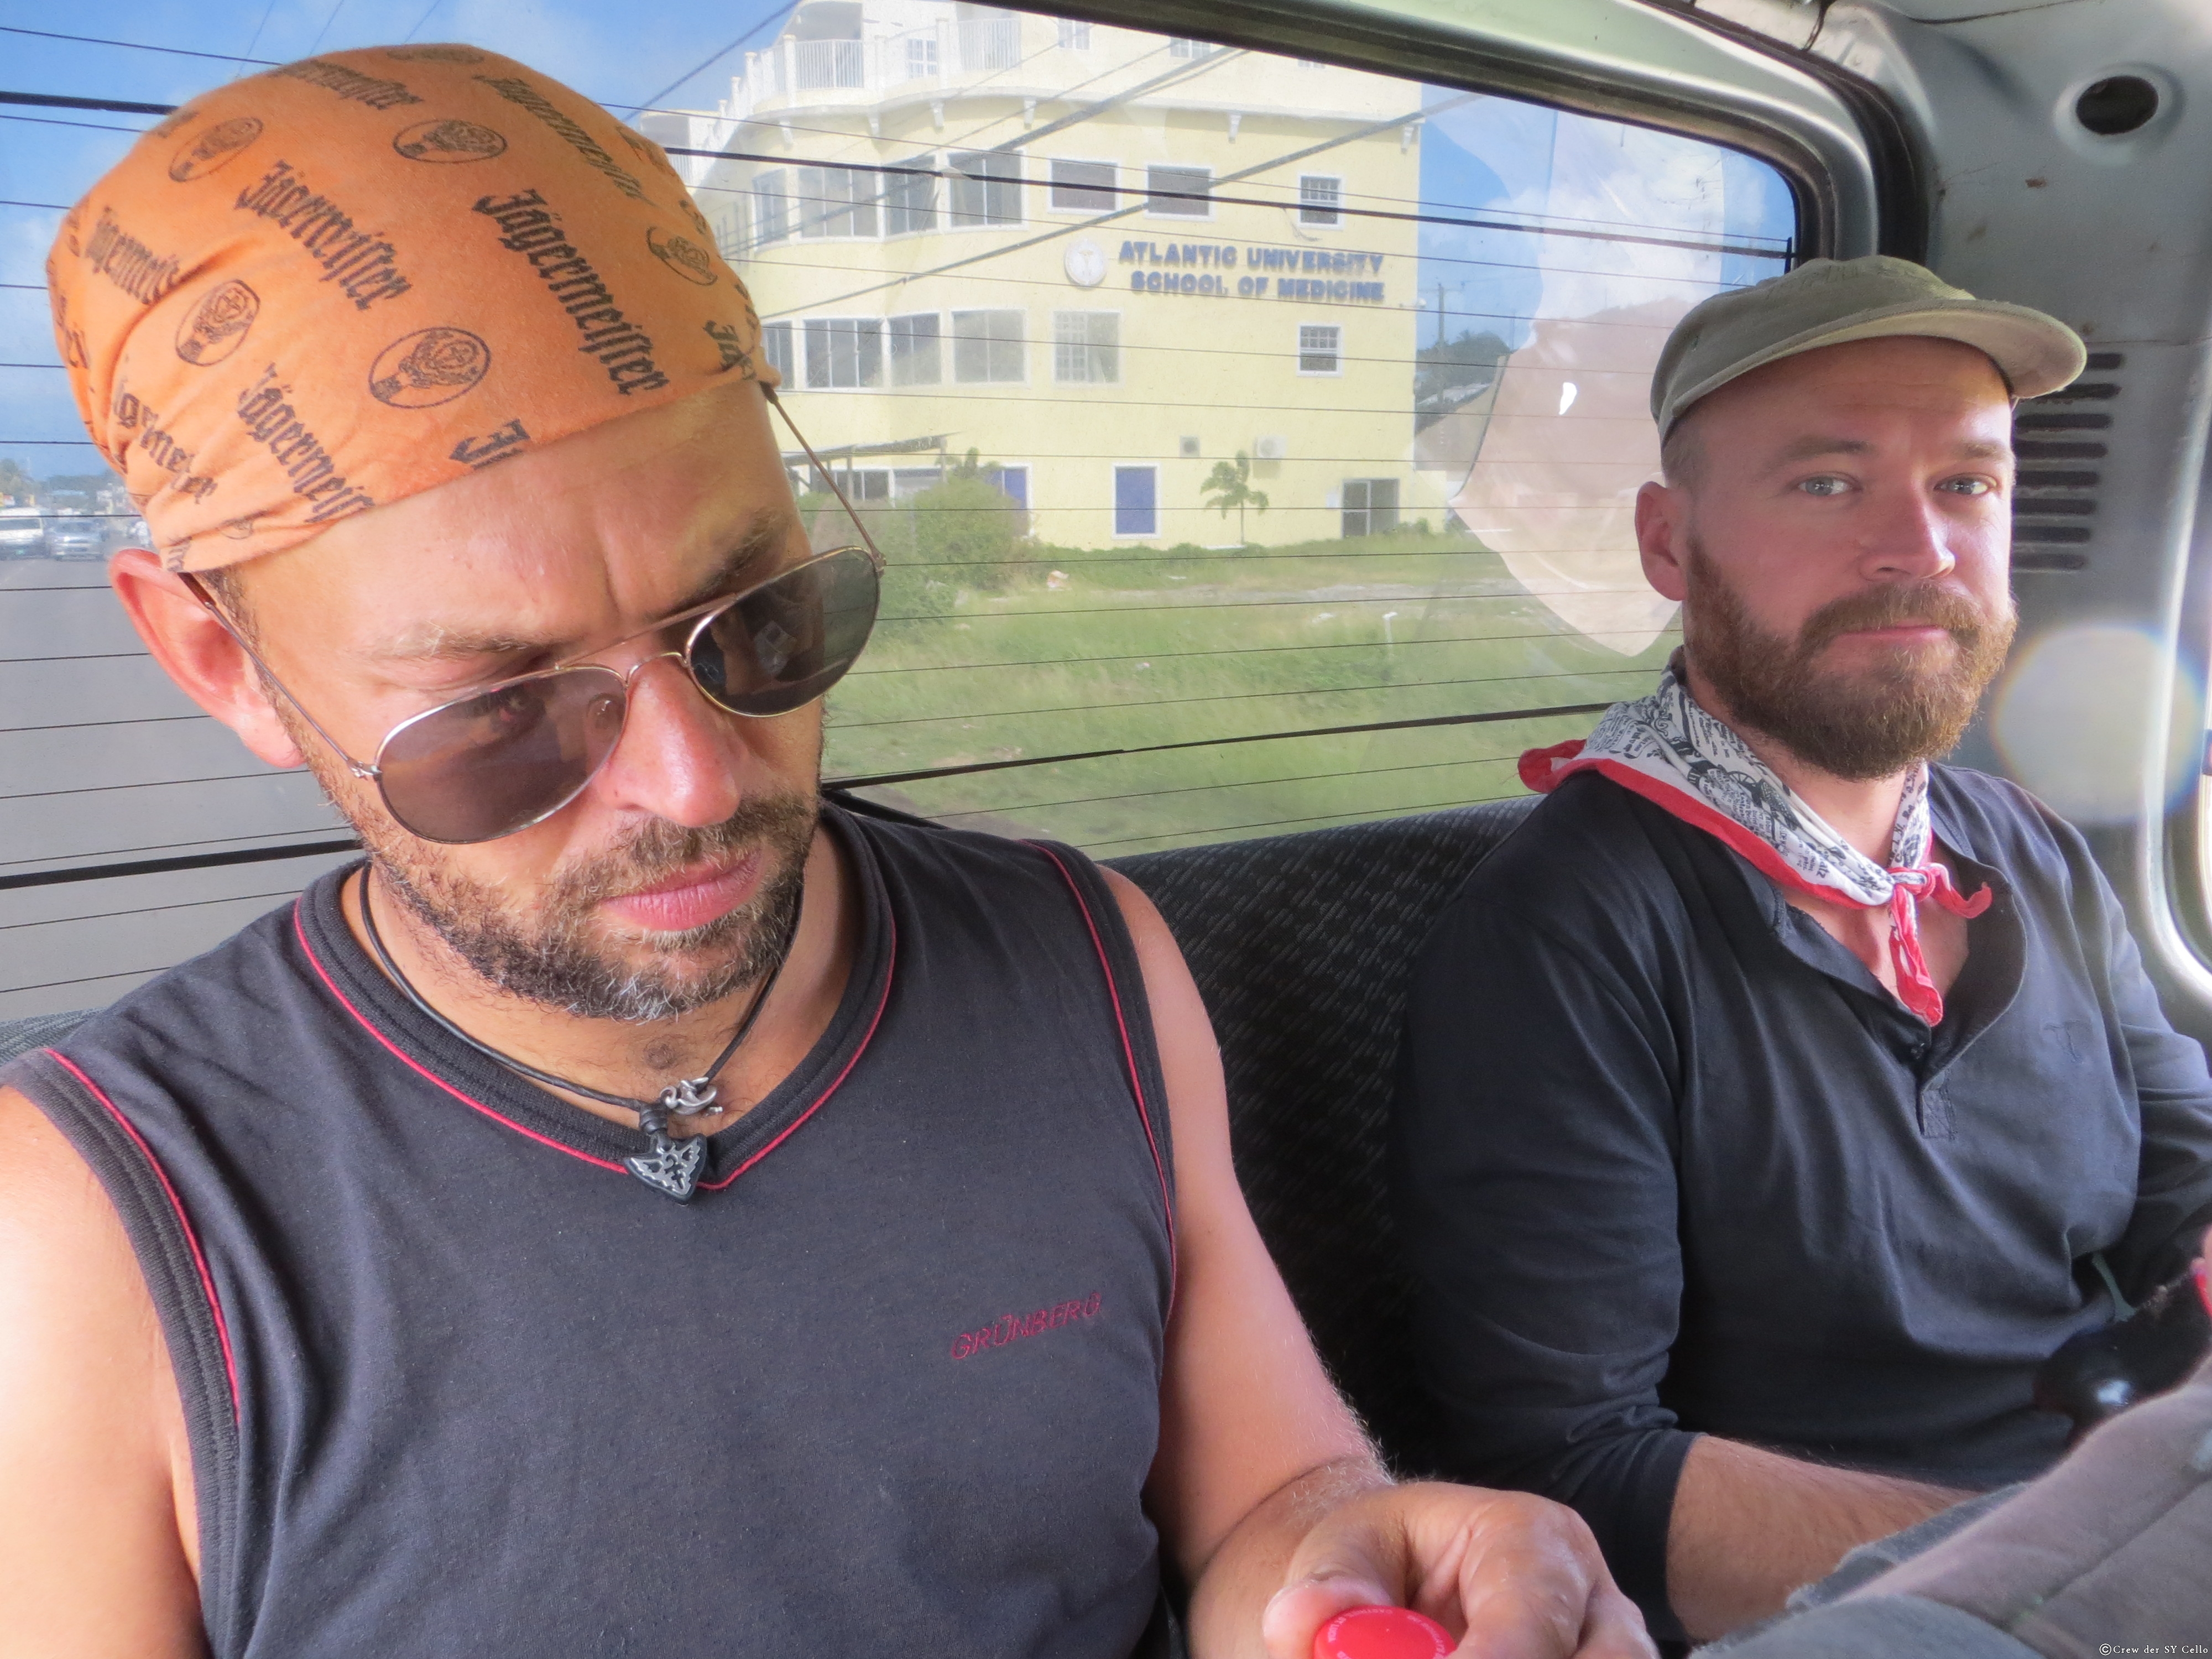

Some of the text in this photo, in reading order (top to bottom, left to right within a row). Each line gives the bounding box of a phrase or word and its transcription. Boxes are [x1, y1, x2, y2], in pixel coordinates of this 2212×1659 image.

[1119, 240, 1384, 274] ATLANTIC UNIVERSITY
[1130, 270, 1385, 302] SCHOOL OF MEDICINE
